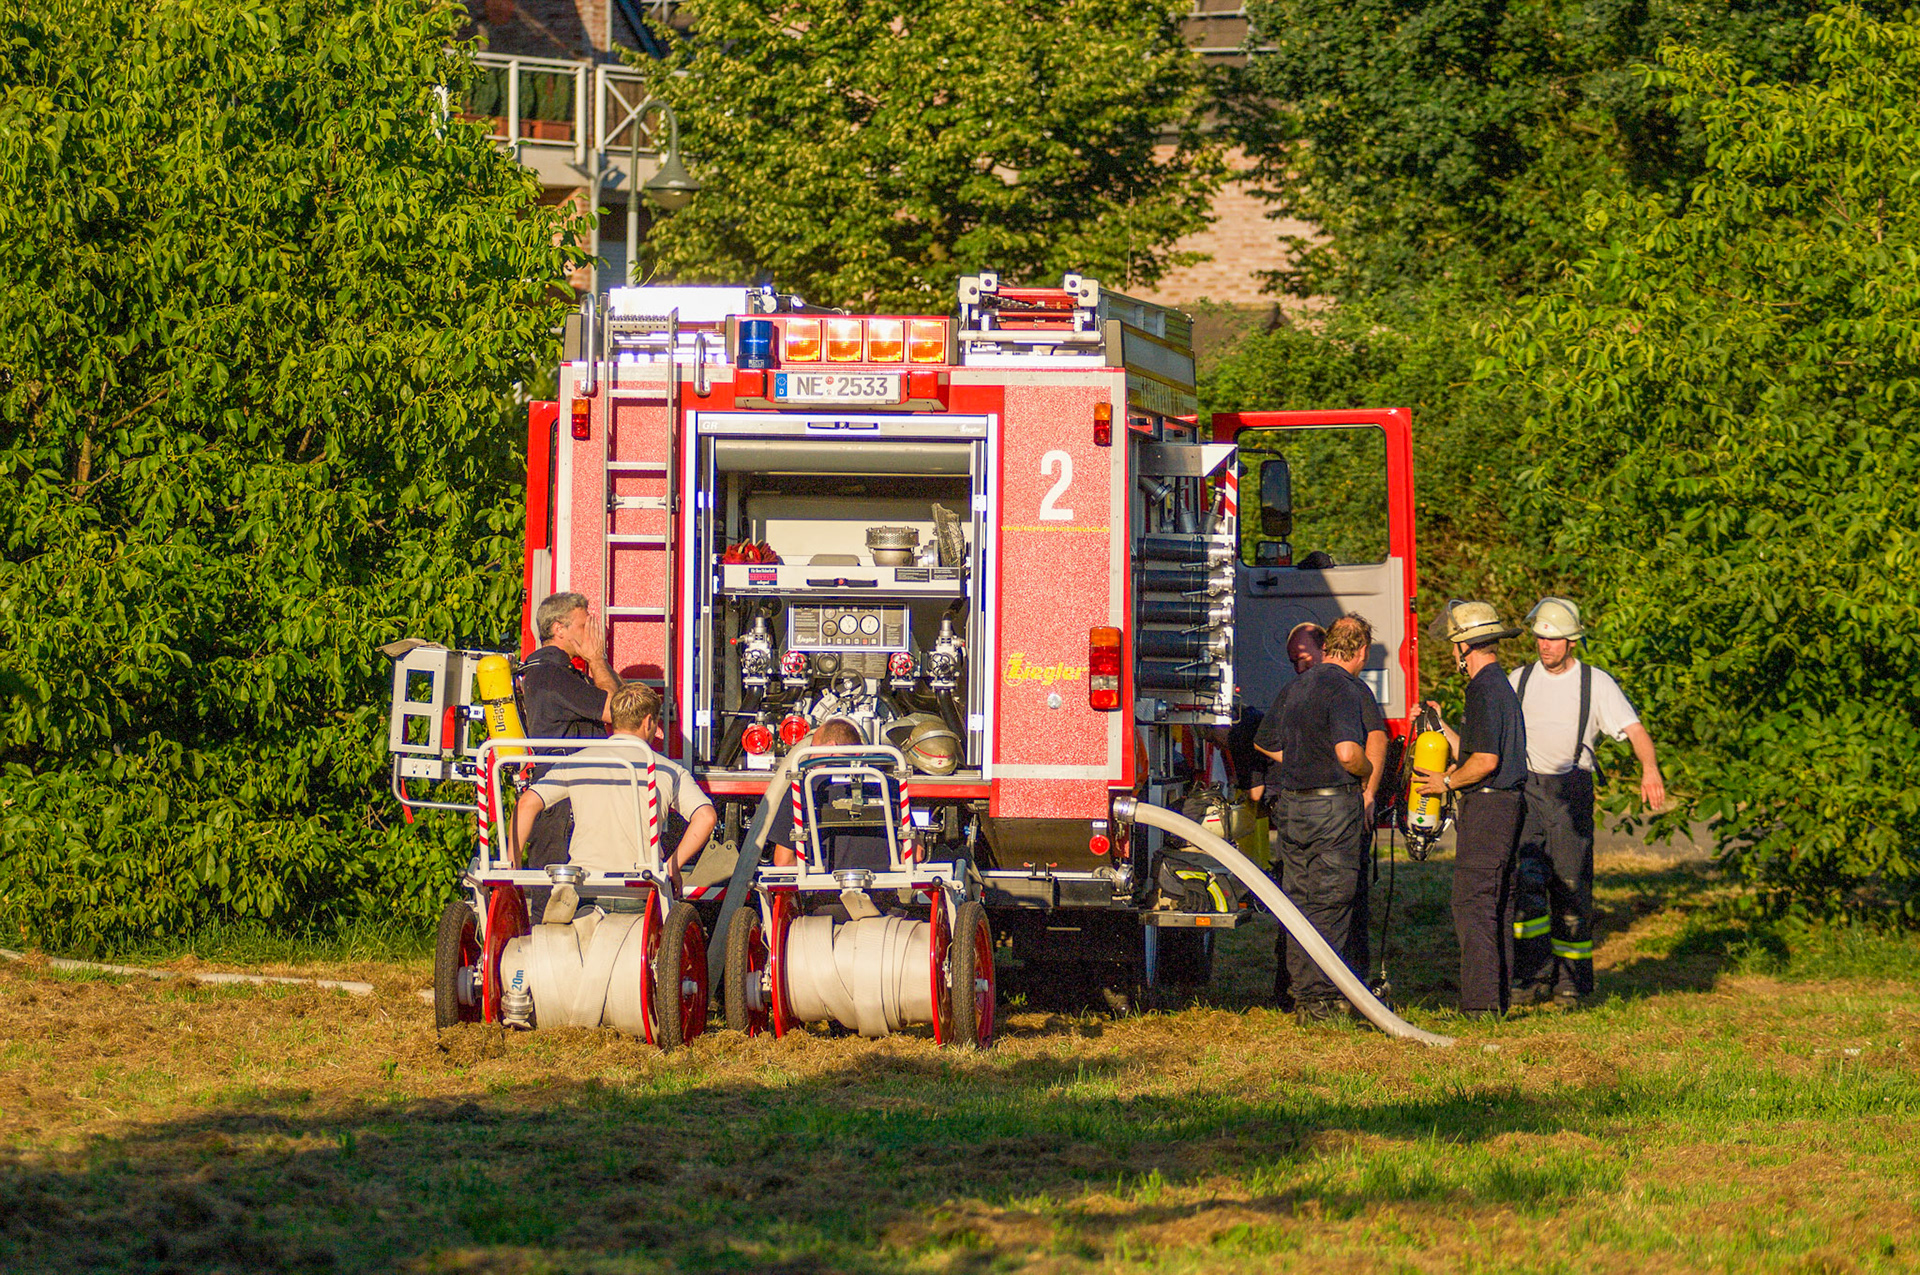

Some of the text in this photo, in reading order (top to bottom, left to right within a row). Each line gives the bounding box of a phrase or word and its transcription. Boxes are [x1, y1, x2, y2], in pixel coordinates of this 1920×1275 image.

[797, 376, 823, 396] NE
[837, 377, 888, 396] 2533
[1039, 449, 1074, 521] 2
[1003, 652, 1087, 687] Ziegler
[511, 969, 525, 992] 20m
